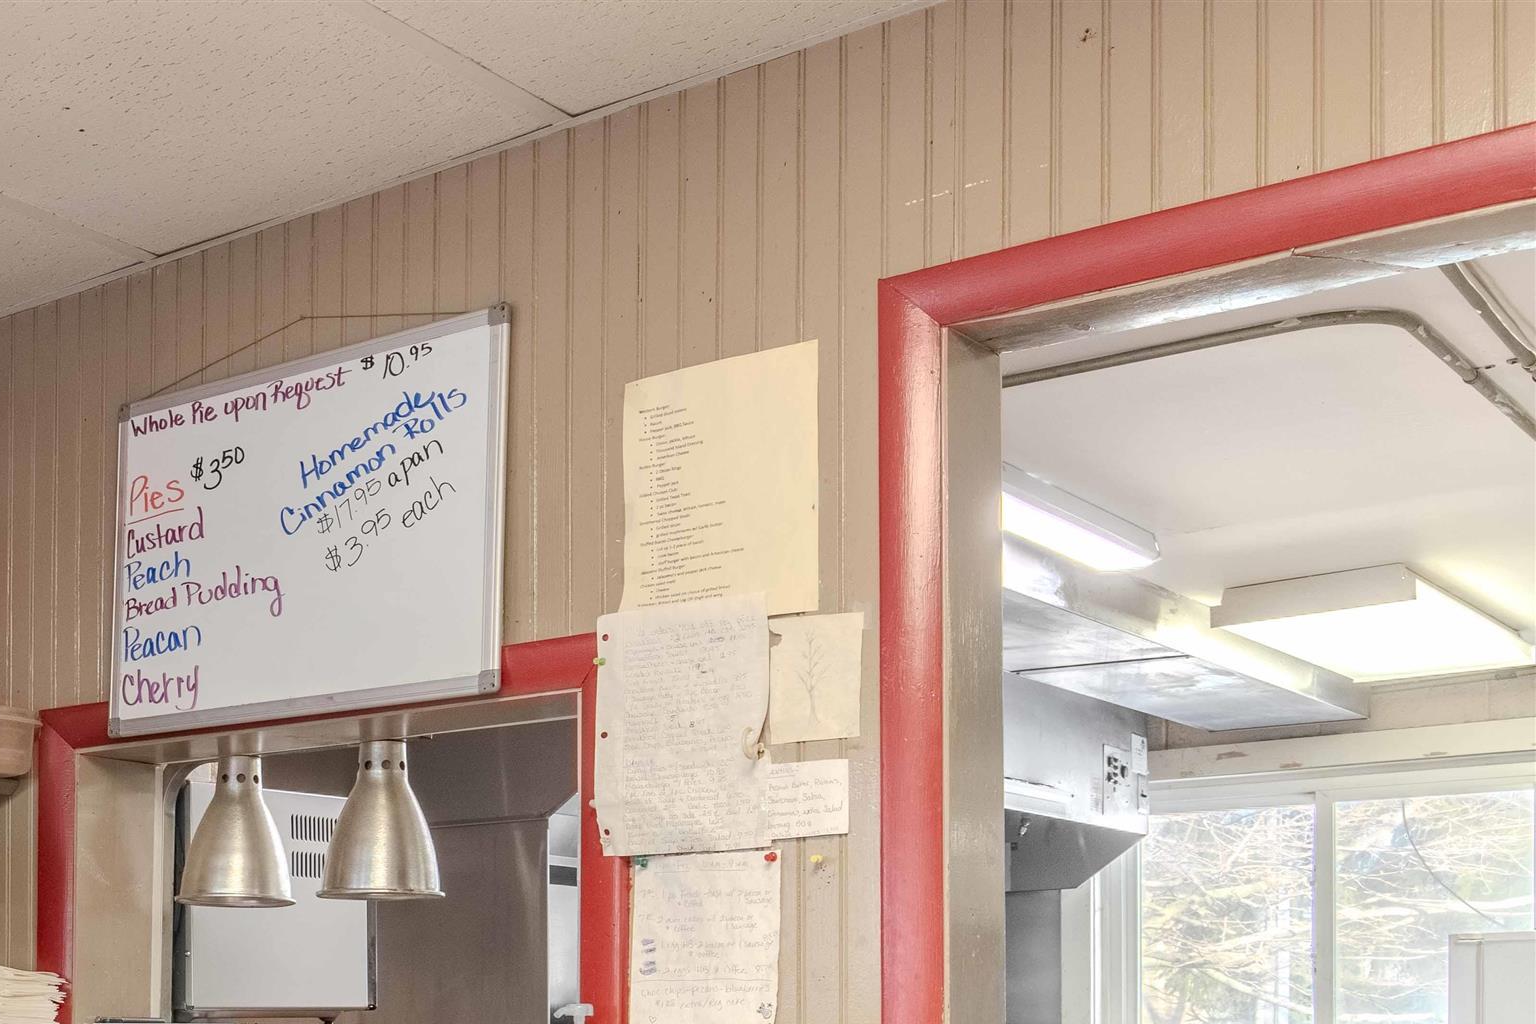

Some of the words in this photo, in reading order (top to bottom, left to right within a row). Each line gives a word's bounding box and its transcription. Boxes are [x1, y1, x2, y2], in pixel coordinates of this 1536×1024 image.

[130, 408, 185, 438] Whole
[192, 399, 218, 425] Pie
[224, 391, 268, 423] upon
[279, 441, 397, 537] Cinnamon
[393, 387, 468, 440] Rolls
[299, 389, 434, 490] Homemade
[129, 475, 185, 518] Pies
[401, 477, 457, 529] each
[127, 506, 205, 559] Custard
[125, 551, 191, 593] Peach
[125, 587, 178, 622] Bread
[180, 564, 285, 618] Pudding
[123, 625, 202, 663] Peacan
[121, 665, 200, 712] Cherry
